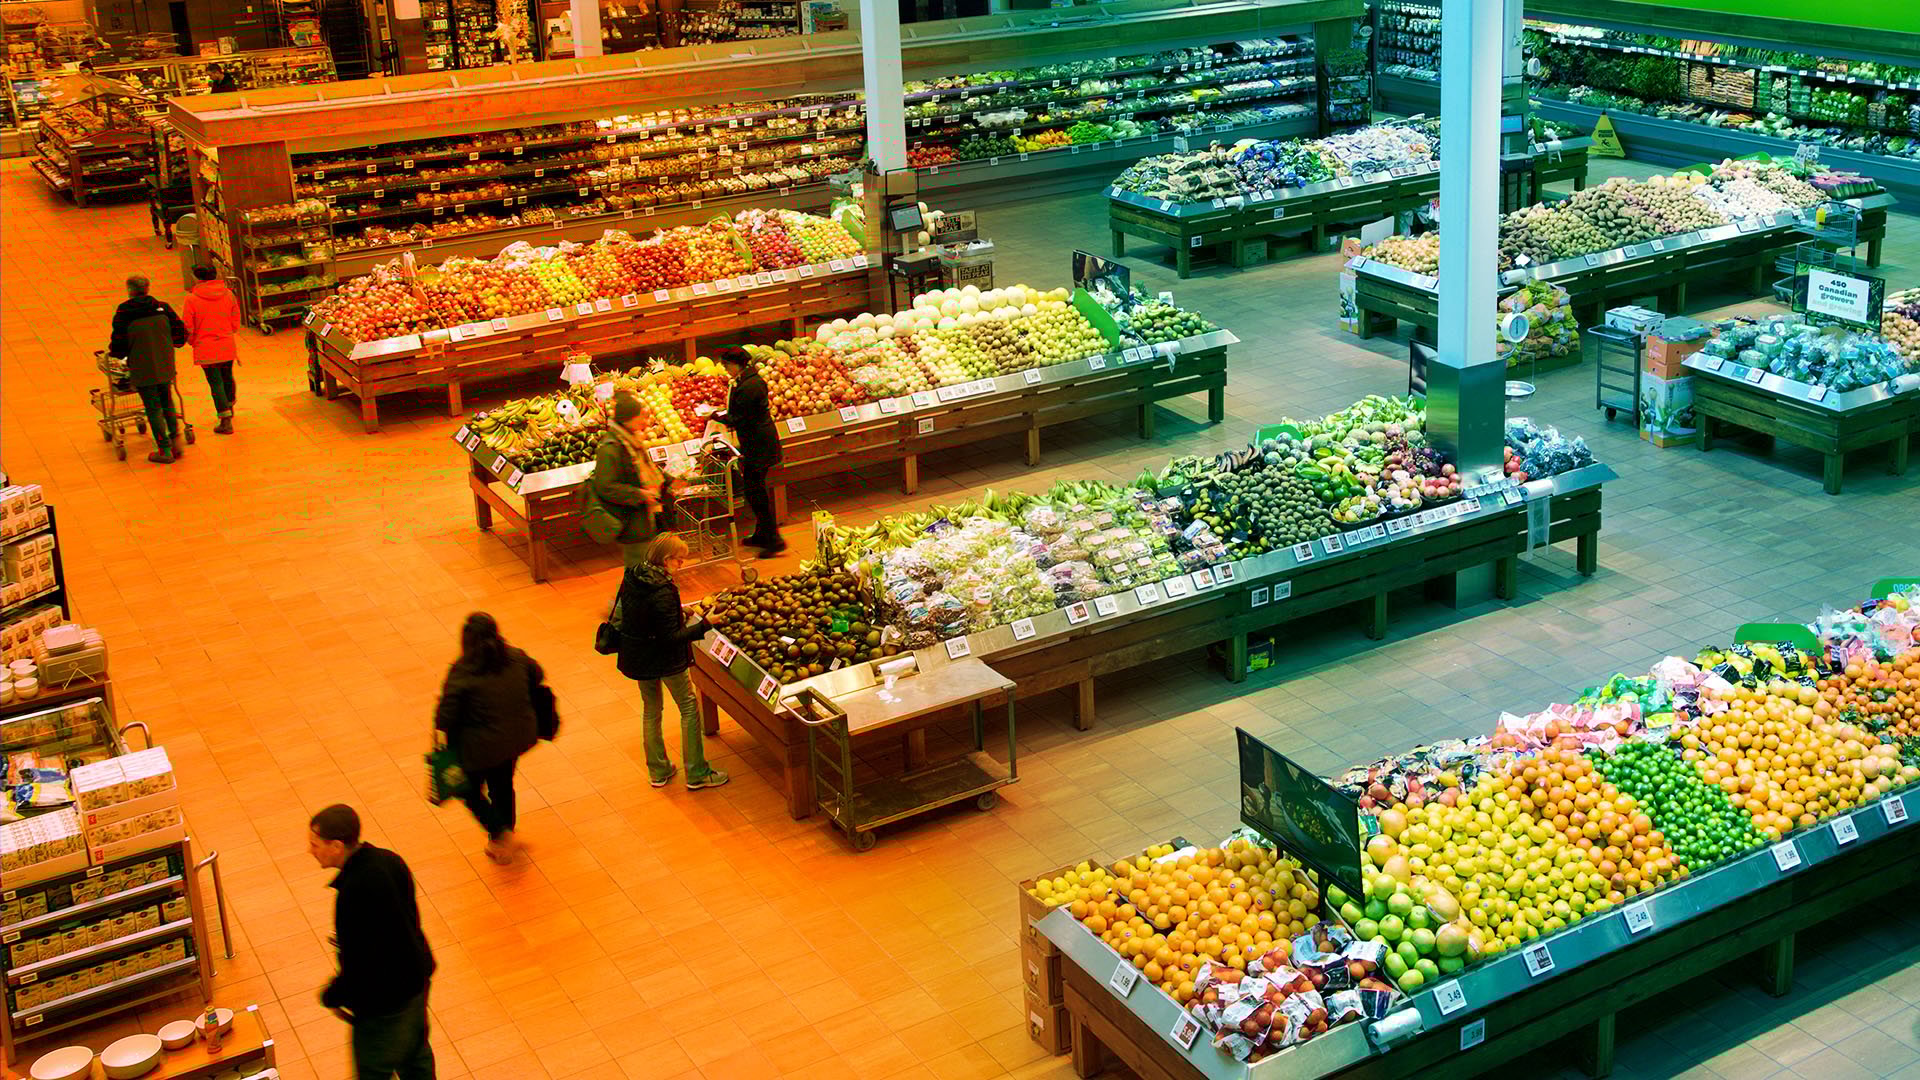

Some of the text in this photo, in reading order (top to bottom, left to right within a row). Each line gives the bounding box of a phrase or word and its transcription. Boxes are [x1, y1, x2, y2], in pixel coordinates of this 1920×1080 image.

[1831, 280, 1847, 288] 450
[1818, 285, 1858, 298] Canadian
[1820, 293, 1855, 305] growers
[1636, 911, 1647, 922] 2.49
[1447, 989, 1461, 1002] 3.49
